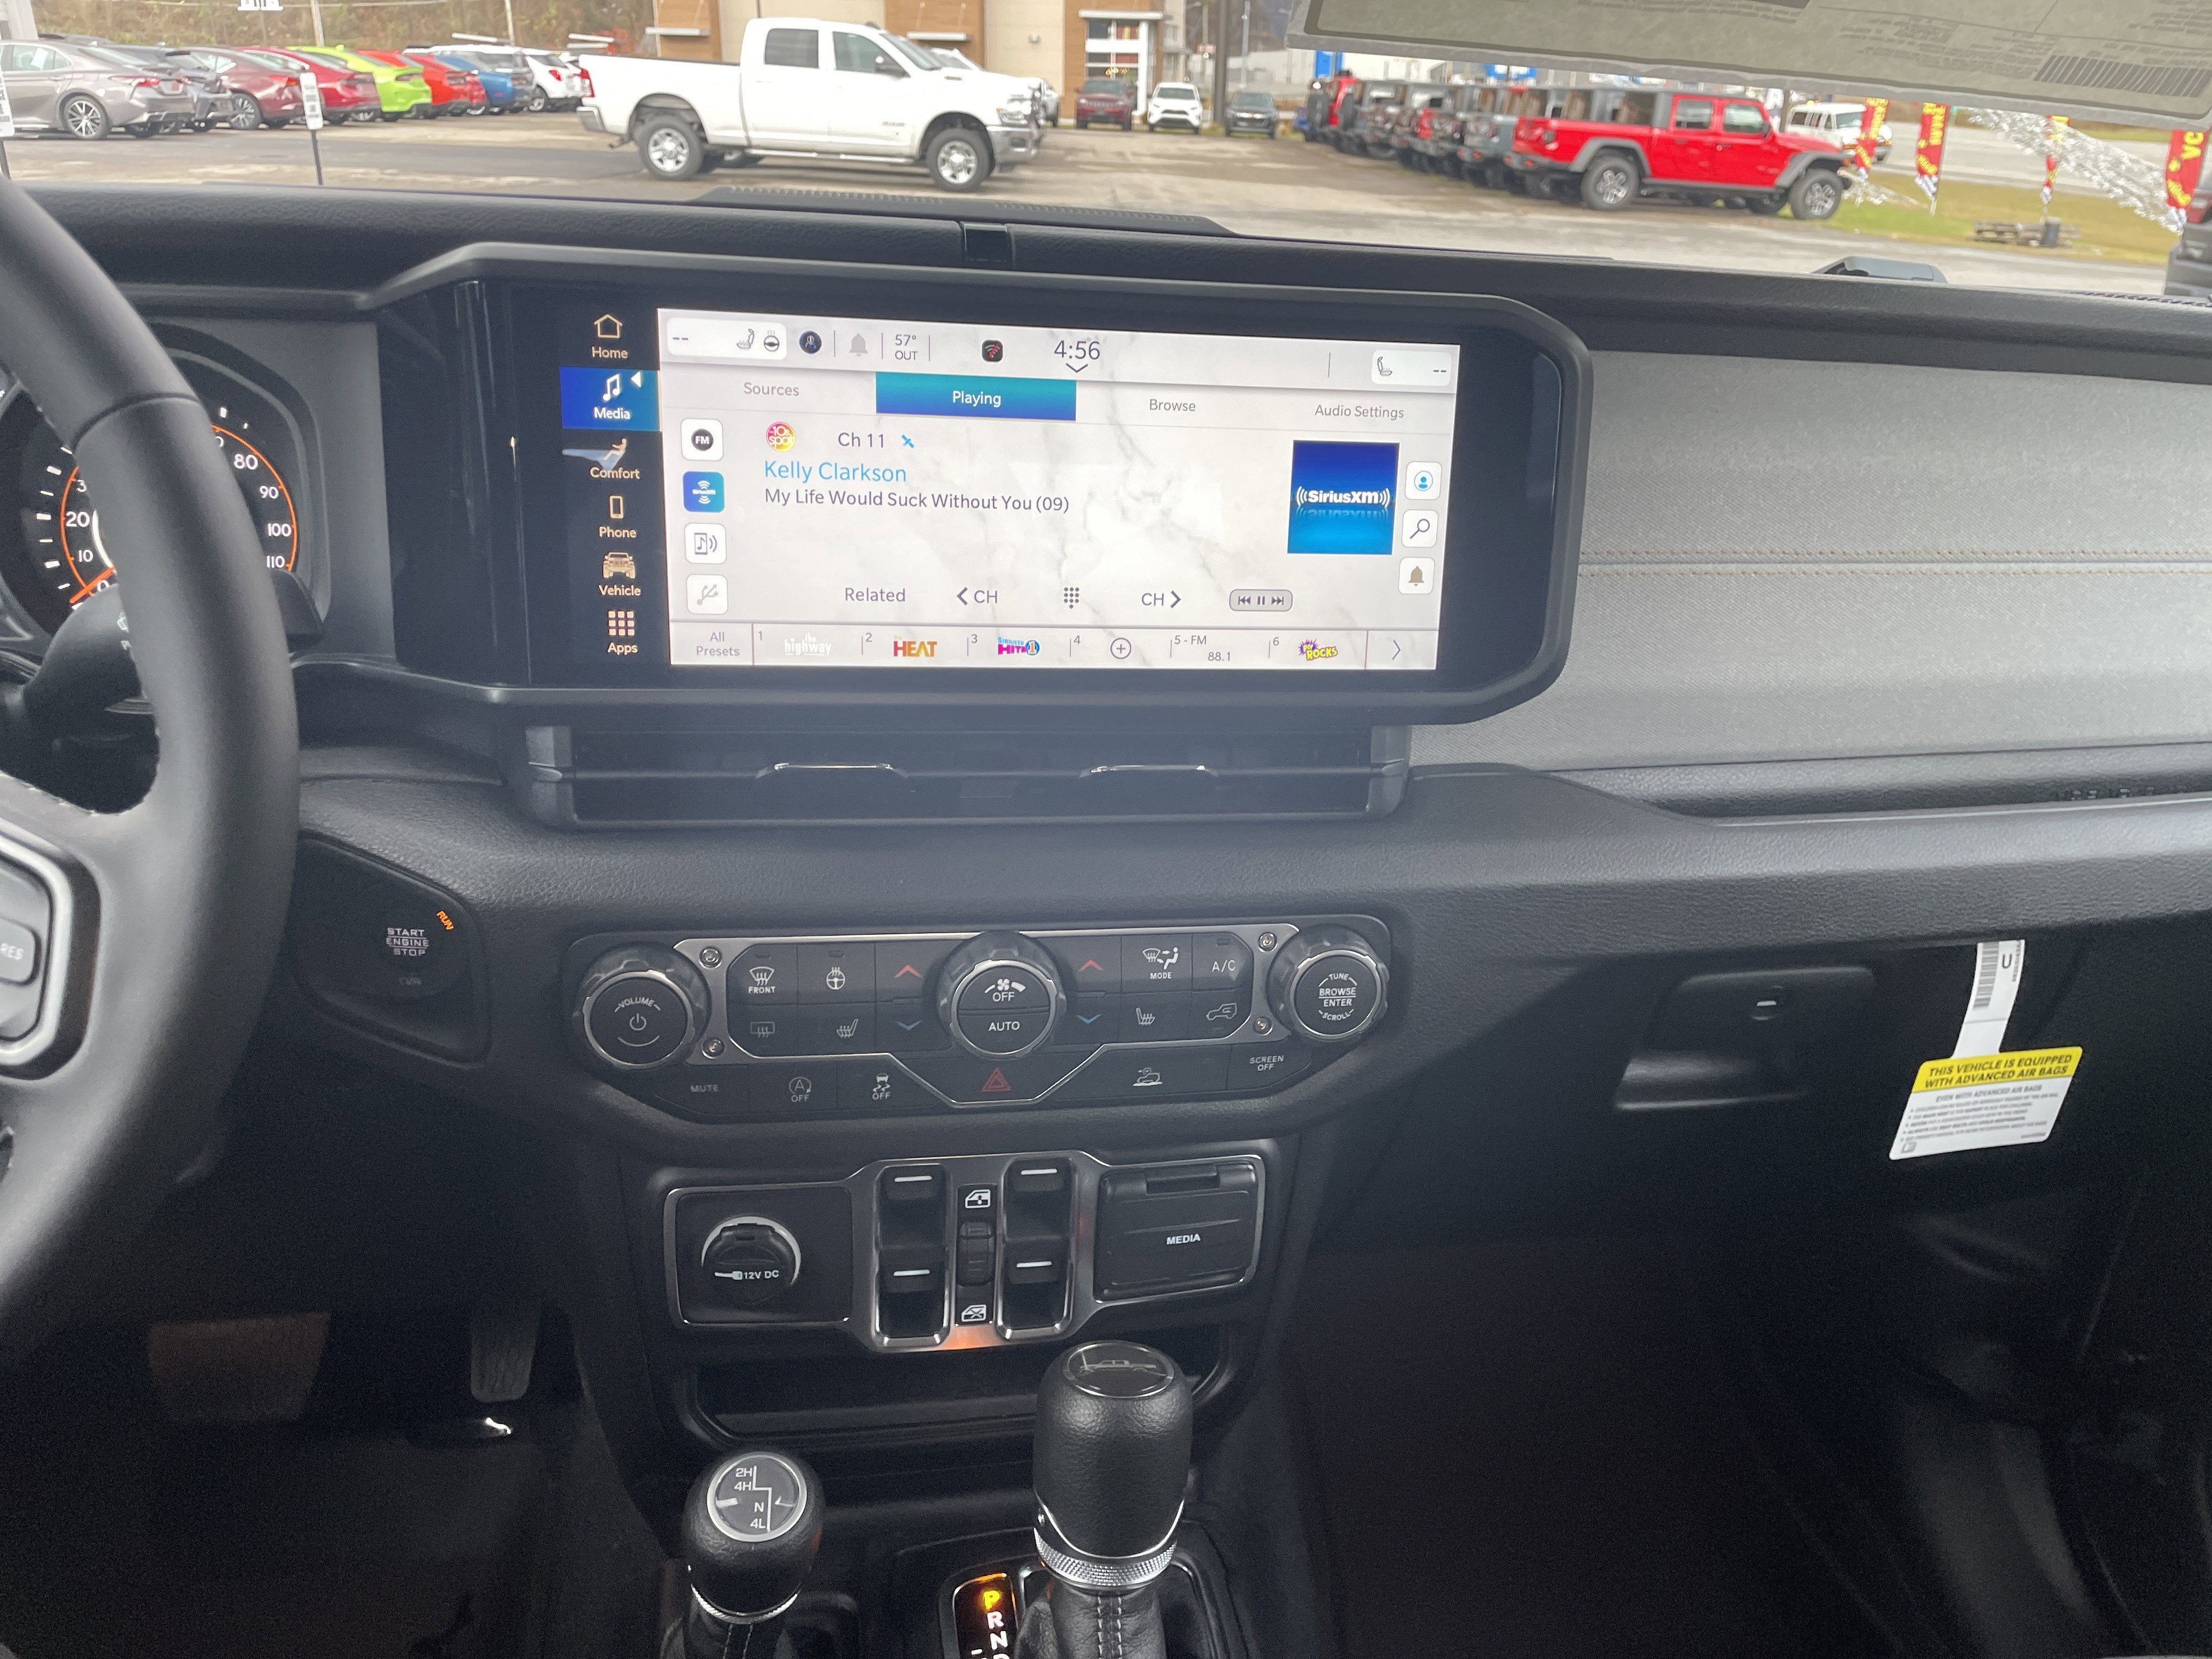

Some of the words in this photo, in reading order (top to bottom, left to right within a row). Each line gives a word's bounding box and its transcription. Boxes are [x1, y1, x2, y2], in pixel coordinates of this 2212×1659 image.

[894, 334, 917, 347] 57°
[591, 346, 628, 359] Home
[895, 350, 918, 361] OUT
[1054, 340, 1100, 359] 4:56
[743, 382, 799, 397] Sources
[952, 390, 1001, 408] Playing
[1149, 399, 1196, 412] Browse
[593, 407, 631, 420] Media
[1314, 404, 1351, 417] Audio
[1354, 405, 1404, 421] Settings
[695, 436, 709, 445] FM
[838, 432, 861, 447] Ch
[867, 433, 884, 448] 11
[234, 453, 259, 470] 80
[590, 466, 640, 480] Comfort
[764, 460, 812, 483] Kelly
[819, 461, 906, 482] Clarkson
[259, 485, 279, 499] 90
[765, 488, 791, 506] My
[795, 489, 824, 504] Life
[828, 490, 883, 506] Would
[887, 492, 927, 508] Suck
[932, 493, 997, 510] Without
[1001, 495, 1032, 511] You
[1036, 495, 1069, 514] (09)
[65, 511, 91, 527] 20
[267, 523, 292, 537] 100
[599, 526, 637, 538] Phone
[78, 550, 94, 563] 10
[266, 555, 285, 568] 110
[599, 584, 641, 596] Vehicle
[845, 587, 906, 602] Related
[974, 590, 998, 604] CH
[1142, 592, 1164, 606] CH
[709, 631, 725, 642] All
[758, 631, 763, 641] 1
[865, 632, 873, 642] 2
[970, 634, 978, 644] 3
[1073, 635, 1081, 645] 4
[1174, 635, 1181, 645] 5
[1190, 635, 1207, 645] FM
[1272, 636, 1279, 646] 6
[607, 642, 638, 655] Apps
[696, 645, 741, 657] Presets
[783, 637, 832, 656] highway
[893, 640, 938, 657] HEAT
[1207, 651, 1231, 662] 88.1
[1306, 646, 1339, 661] ROCKS
[437, 911, 454, 930] RUN
[387, 928, 425, 937] START
[386, 937, 430, 947] ENGINE
[1212, 960, 1235, 973] A/C
[2002, 954, 2012, 969] U
[1150, 972, 1172, 980] MODE
[1328, 973, 1350, 981] TUNE
[748, 985, 776, 994] FRONT
[1319, 987, 1357, 996] BROWSE
[618, 996, 655, 1008] VOLUME
[992, 992, 1015, 1002] OFF
[1323, 998, 1352, 1007] ENTER
[1322, 1012, 1351, 1021] SCROLL
[988, 1021, 1020, 1031] AUTO
[1249, 1055, 1284, 1064] SCREEN
[1929, 1066, 1953, 1077] THIS
[1956, 1062, 2000, 1074] VEHICLE
[2005, 1059, 2016, 1069] IS
[2017, 1054, 2073, 1067] EQUIPPED
[1257, 1063, 1274, 1071] OFF
[1925, 1077, 1954, 1088] WITH
[1955, 1070, 2015, 1085] ADVANCED
[2018, 1068, 2035, 1077] AIR
[2039, 1065, 2069, 1076] BAGS
[690, 1084, 720, 1093] MUTE
[791, 1094, 810, 1103] OFF
[872, 1091, 891, 1101] OFF
[1166, 1233, 1201, 1245] MEDIA
[743, 1271, 762, 1280] 12V
[764, 1269, 779, 1279] DC
[735, 1467, 753, 1477] 2H
[734, 1481, 752, 1491] 4H
[754, 1502, 765, 1513] N
[750, 1517, 766, 1529] 4L
[983, 1590, 1001, 1611] P
[986, 1611, 1005, 1629] R
[990, 1630, 1008, 1651] N
